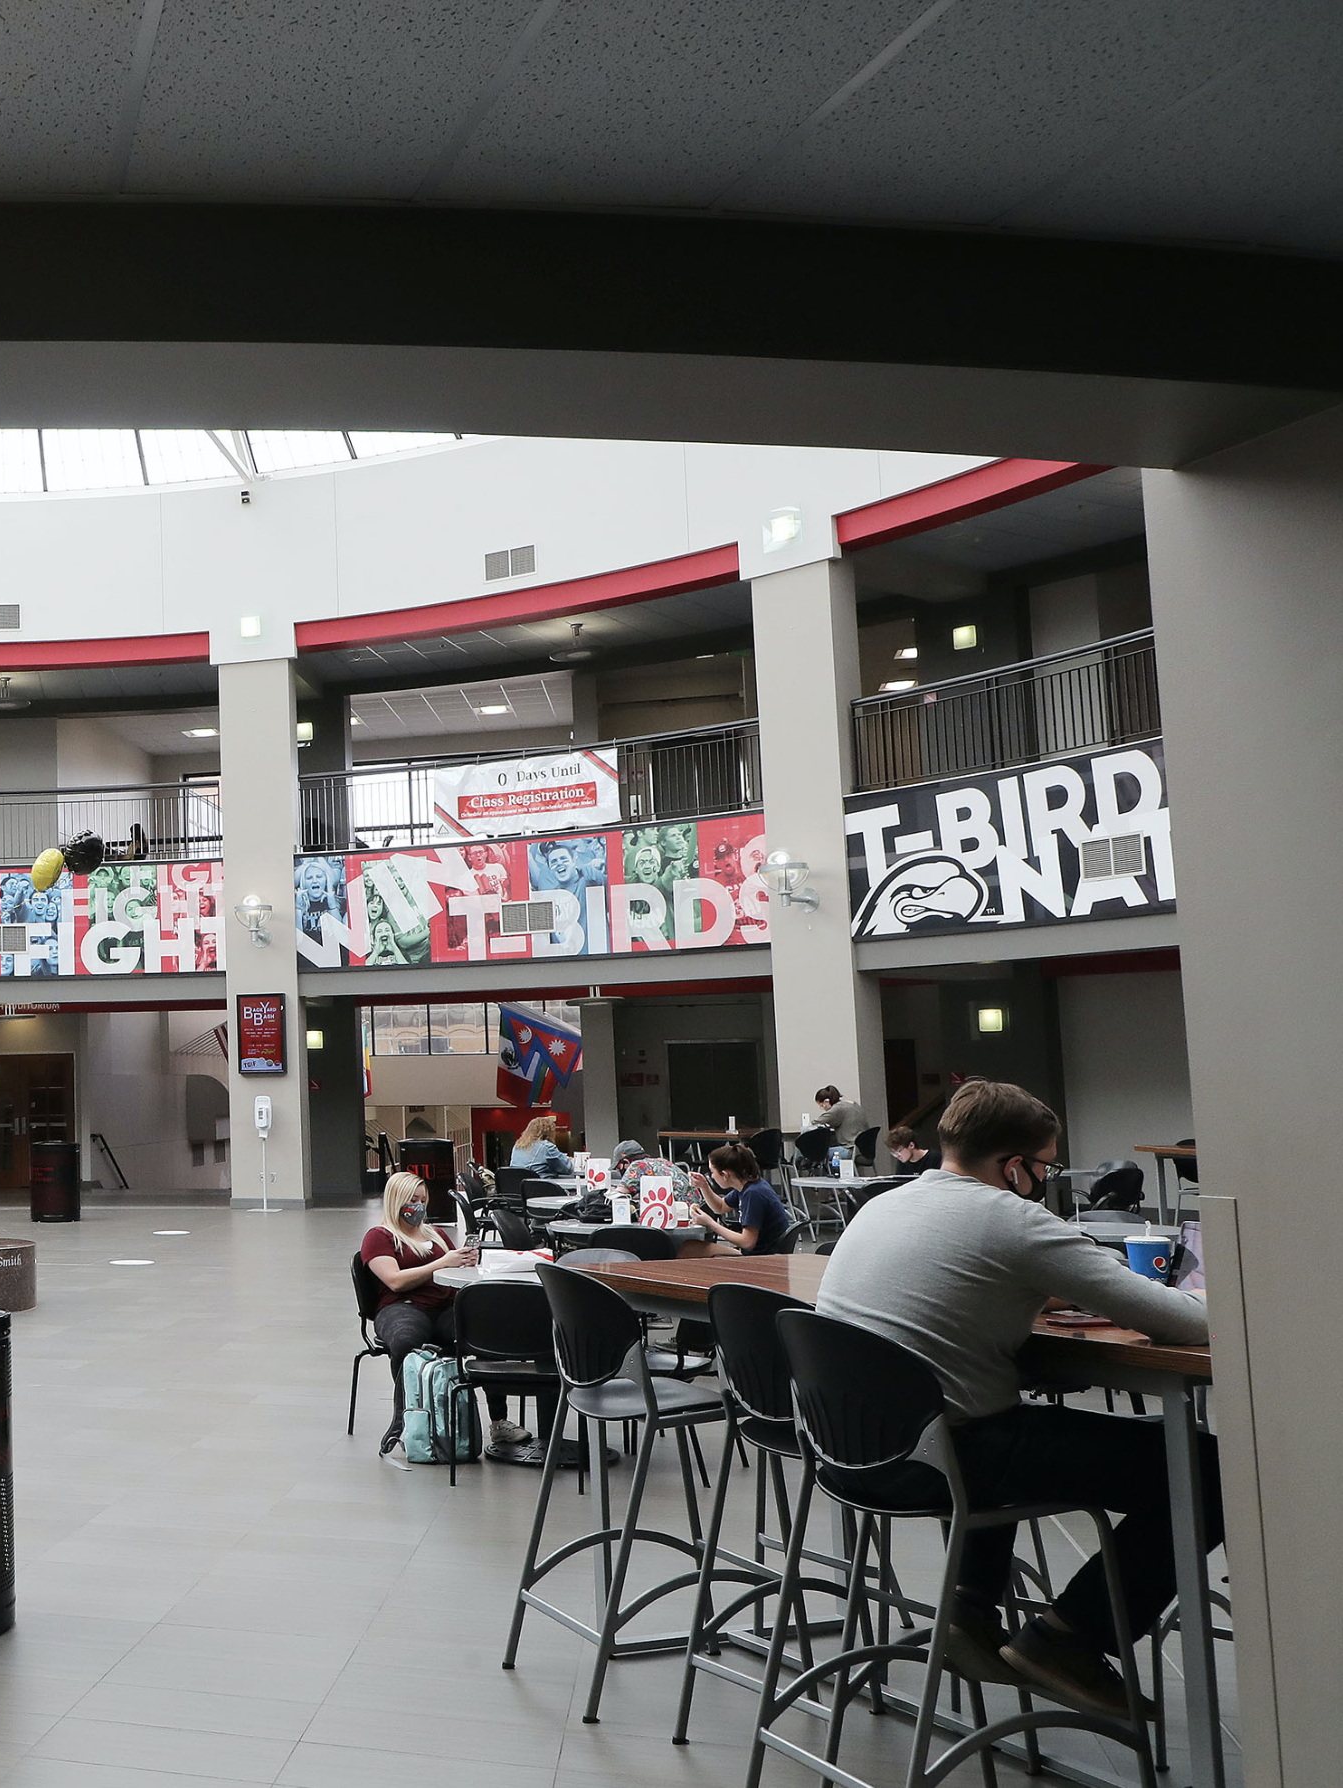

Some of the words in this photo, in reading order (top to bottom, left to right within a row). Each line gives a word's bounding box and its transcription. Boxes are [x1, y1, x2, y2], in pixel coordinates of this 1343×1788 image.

[497, 772, 508, 787] 0
[516, 769, 547, 782] Days
[551, 763, 581, 778] Until
[469, 796, 505, 809] Class
[507, 787, 585, 806] Registration
[844, 749, 1164, 888] T-BIRD
[447, 873, 771, 961] T-BIRDS
[6, 1003, 60, 1011] UDITORIUM
